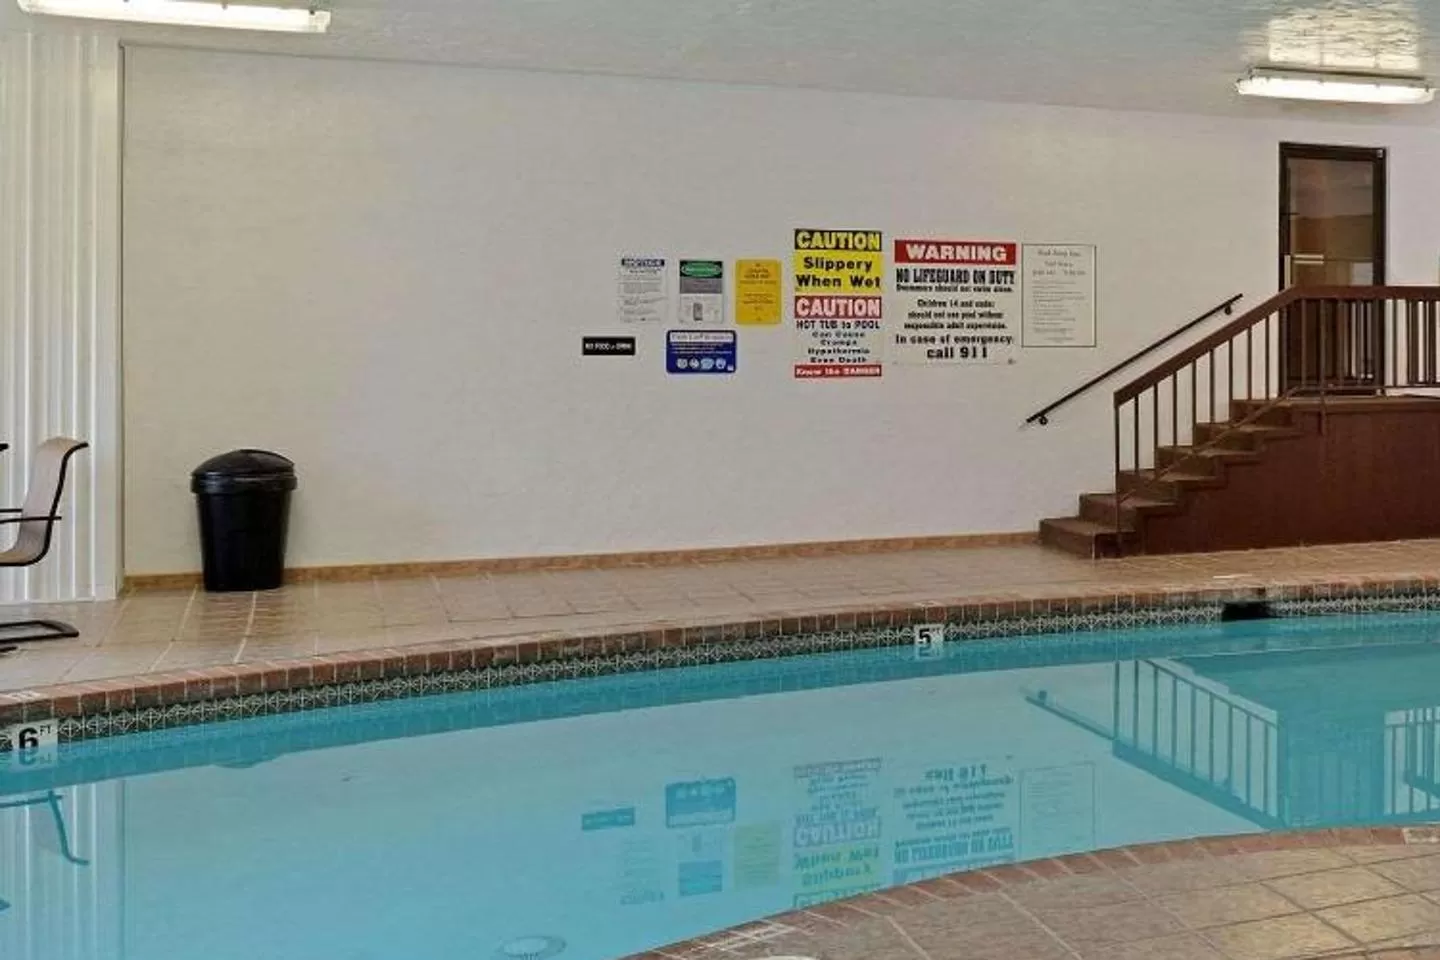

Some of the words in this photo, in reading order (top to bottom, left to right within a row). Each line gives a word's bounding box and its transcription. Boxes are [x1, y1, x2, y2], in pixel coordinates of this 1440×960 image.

[796, 230, 880, 250] CAUTION
[905, 243, 1007, 262] WARNING
[803, 256, 873, 273] Slippery
[796, 274, 842, 288] When
[850, 275, 881, 288] Wet
[896, 268, 909, 283] NO
[913, 268, 970, 284] LIFEGUARD
[973, 270, 986, 284] ON
[989, 270, 1015, 285] DUTY
[796, 297, 880, 317] CAUTION
[796, 320, 816, 330] HOT
[819, 320, 838, 329] TUB
[854, 320, 880, 329] POOL
[895, 334, 907, 344] In
[909, 335, 936, 344] case
[940, 334, 951, 344] of
[926, 346, 954, 359] call
[960, 346, 988, 359] 911
[918, 628, 932, 647] 5
[19, 727, 39, 752] 6
